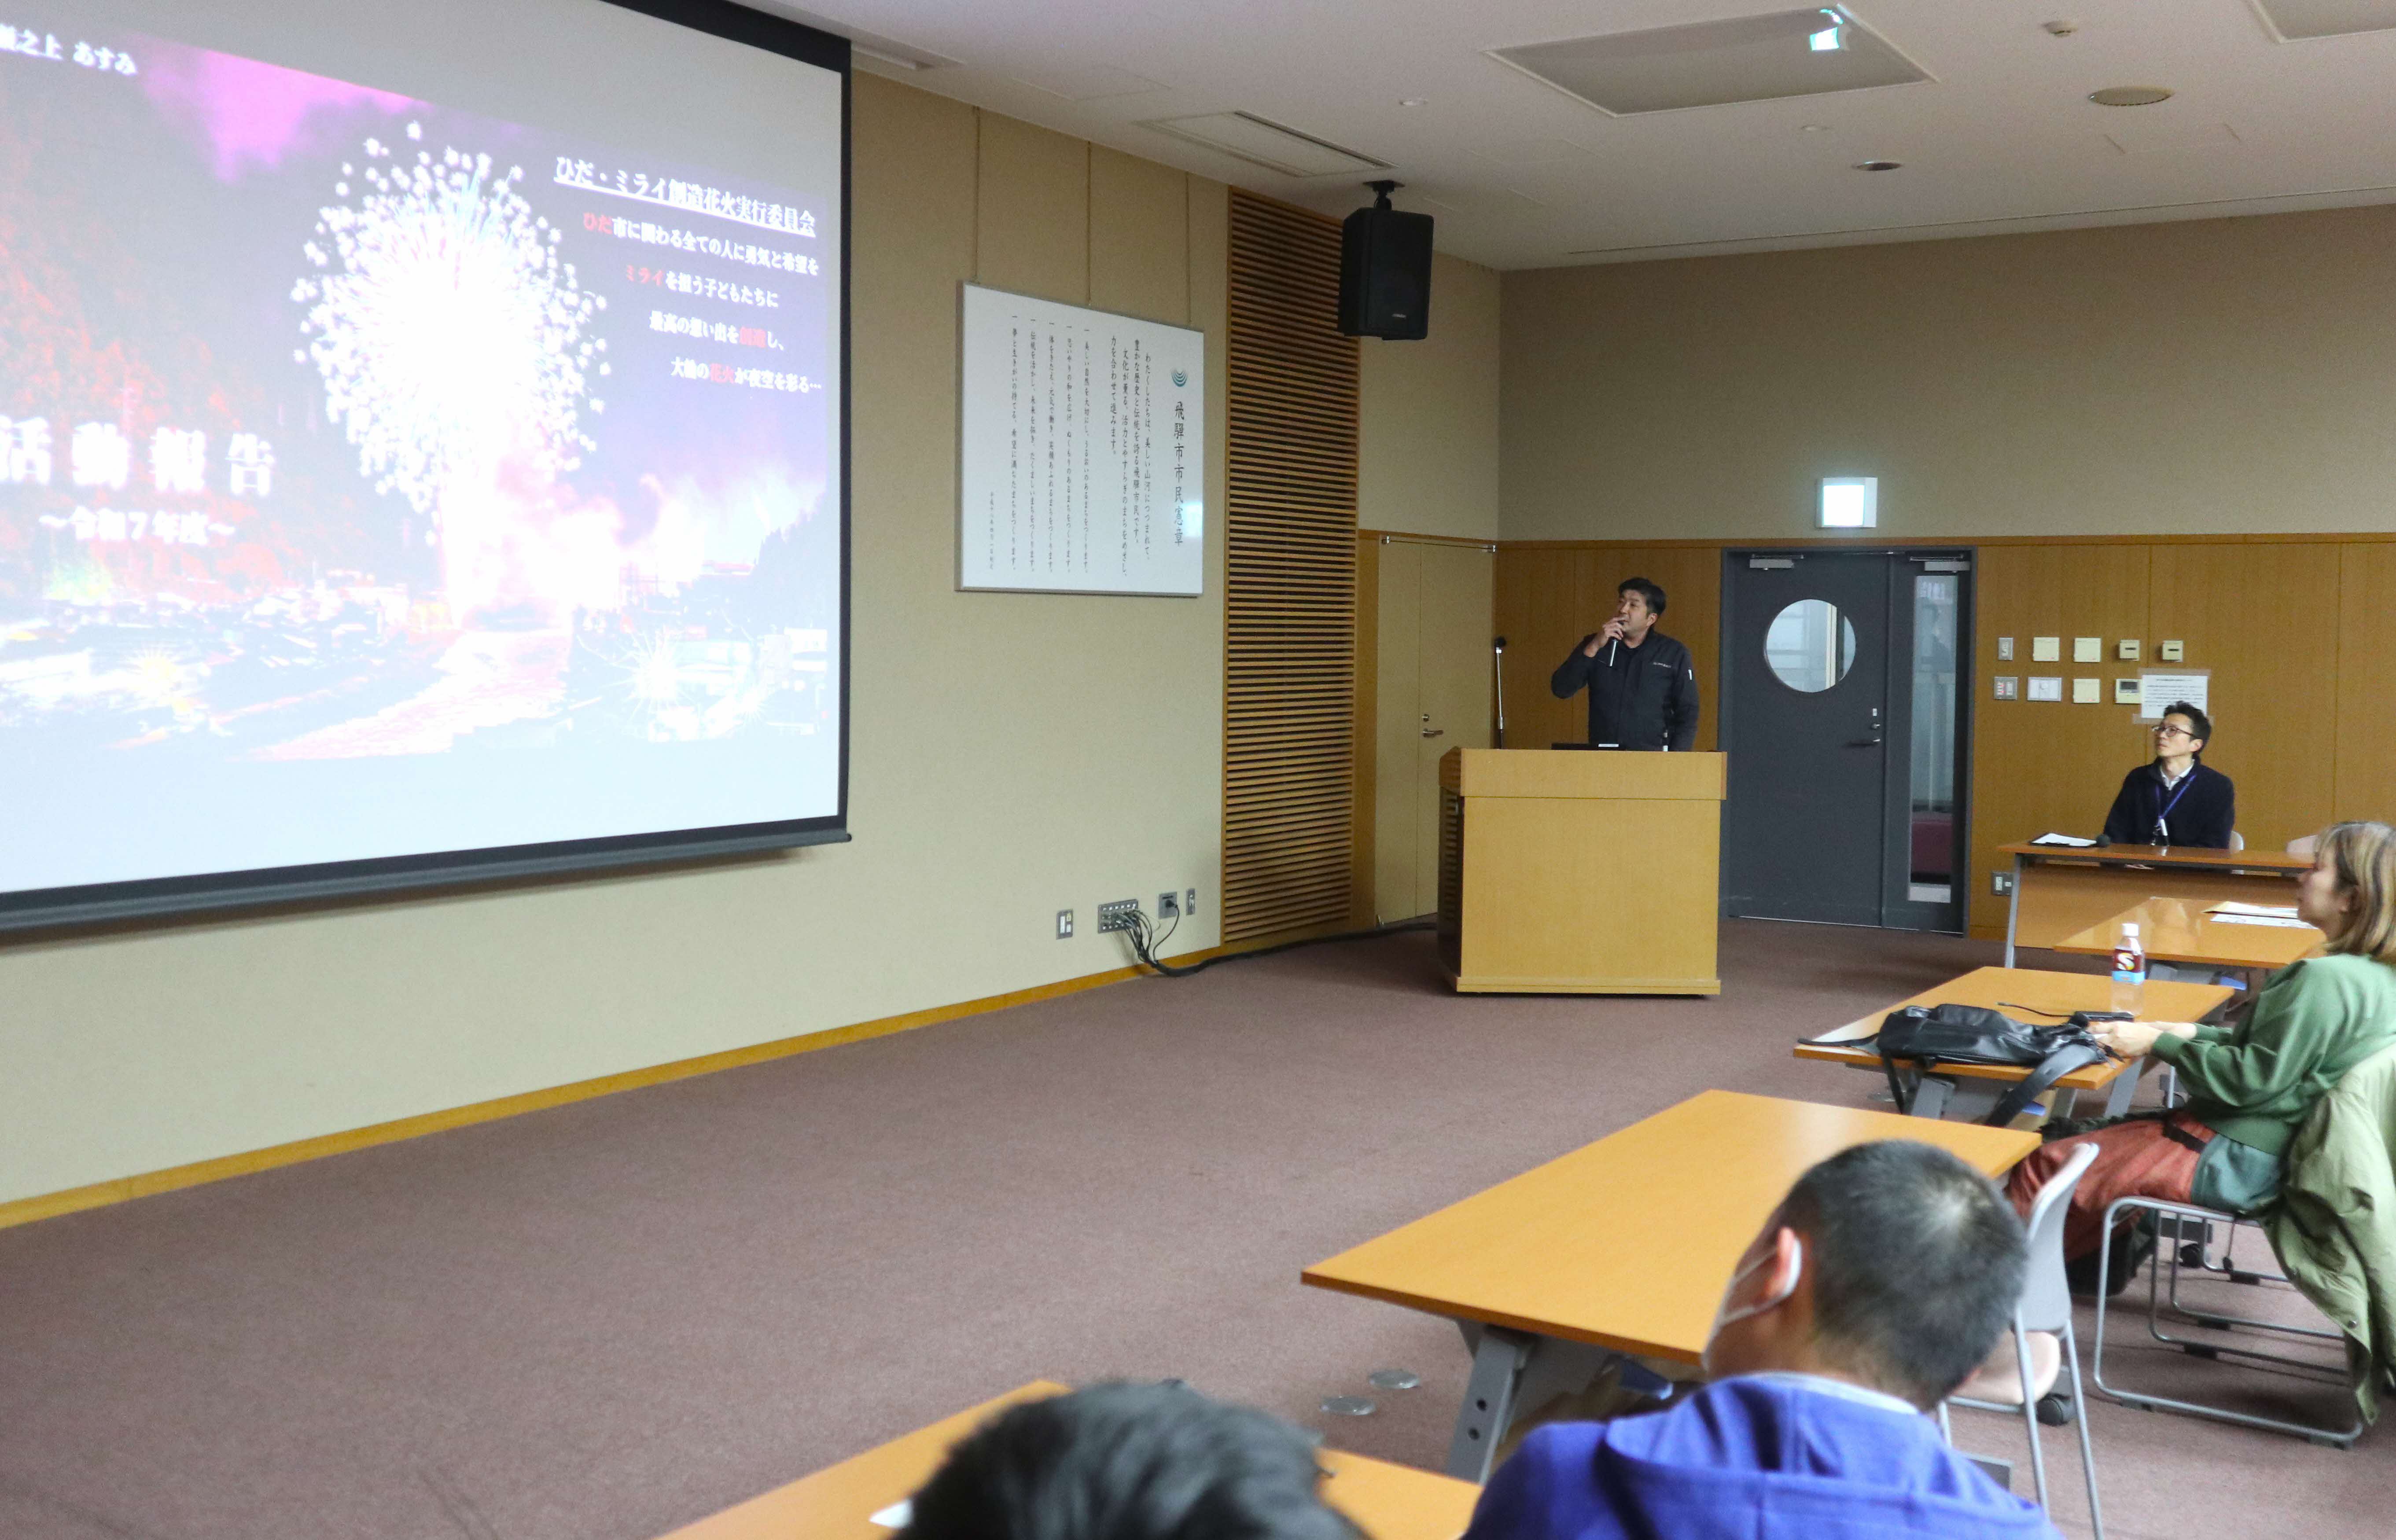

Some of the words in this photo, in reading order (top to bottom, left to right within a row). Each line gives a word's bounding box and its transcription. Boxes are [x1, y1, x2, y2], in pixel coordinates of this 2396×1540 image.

[555, 155, 816, 234] ひだ・ミライ創造花火実行委員会
[583, 212, 819, 276] ひだ市に関わる全ての人に勇気と希望を
[626, 264, 779, 308] ミライを担う子どもたちに
